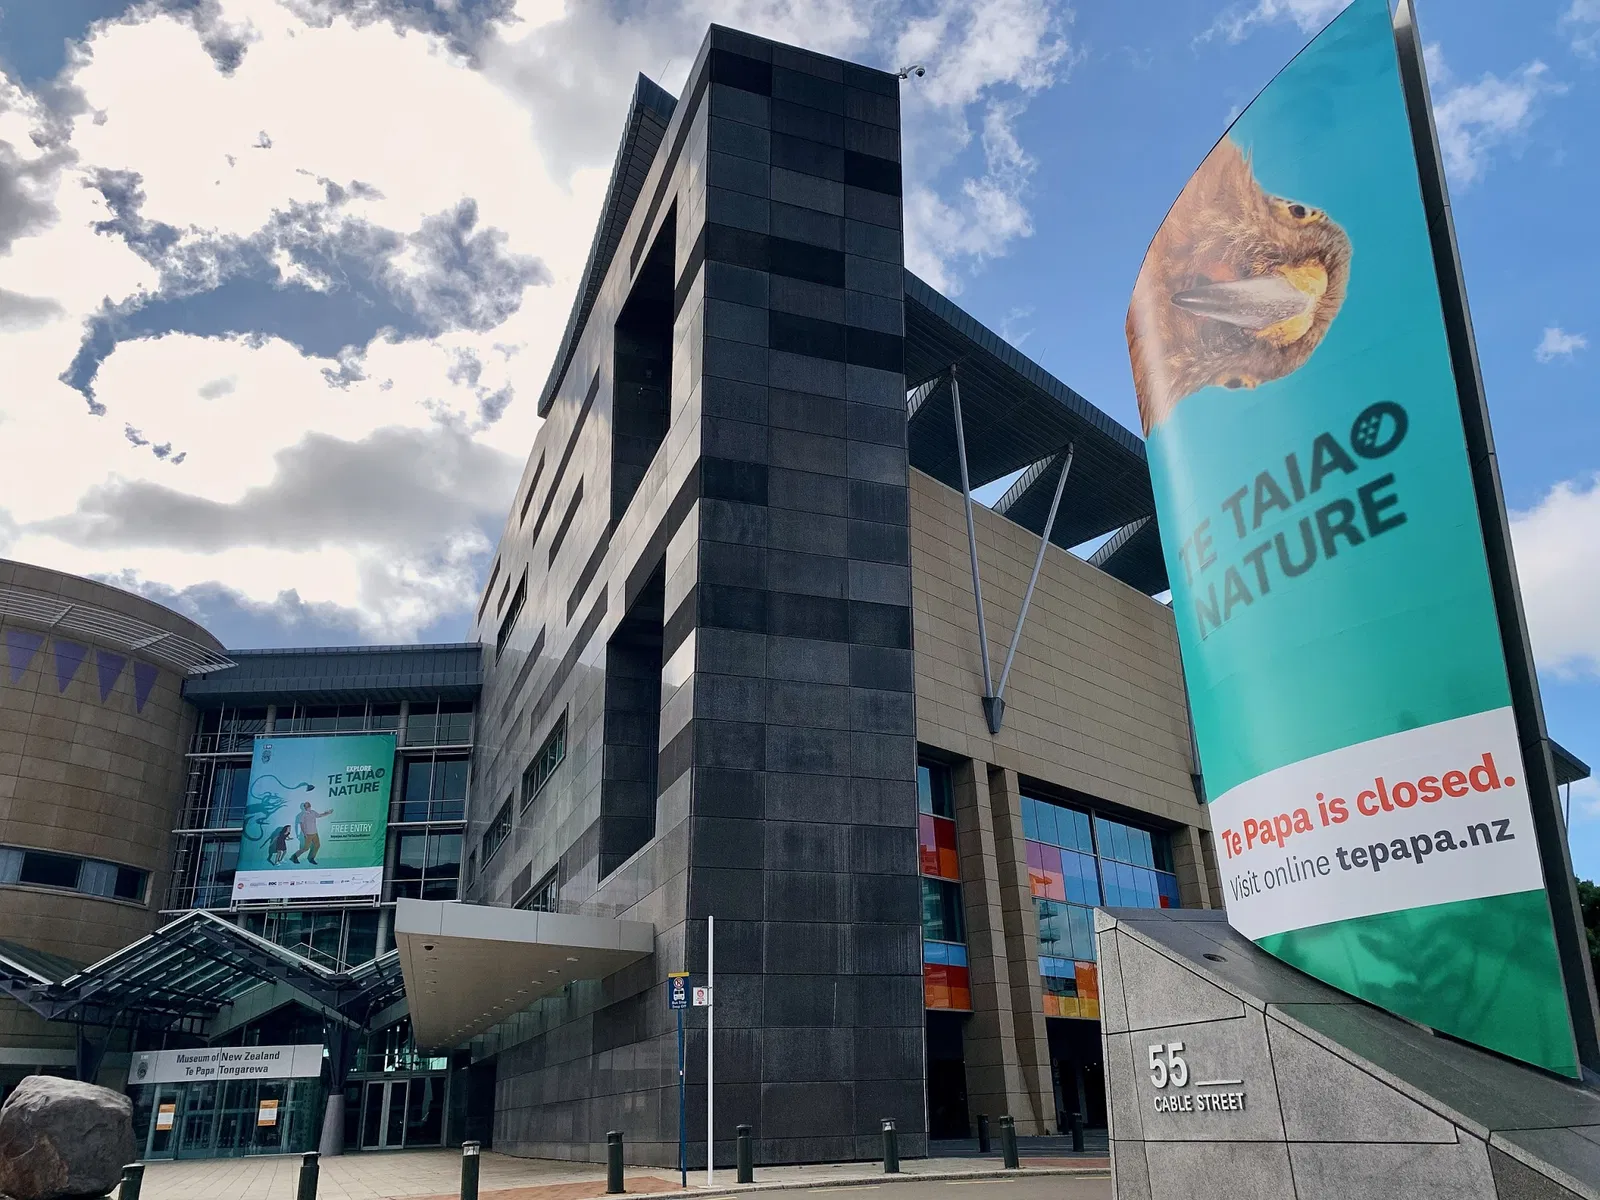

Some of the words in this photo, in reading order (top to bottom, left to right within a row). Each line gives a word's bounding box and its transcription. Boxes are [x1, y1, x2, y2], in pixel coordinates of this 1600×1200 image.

[1178, 518, 1217, 586] TE
[1194, 472, 1408, 641] NATURE
[327, 773, 342, 785] TE
[328, 781, 380, 798] NATURE
[1221, 828, 1242, 860] Te
[1243, 806, 1314, 850] Papa
[1315, 792, 1350, 828] is
[1356, 752, 1516, 817] closed.
[331, 824, 349, 833] FREE
[350, 823, 373, 833] ENTRY
[1230, 870, 1261, 901] Visit
[1264, 855, 1331, 890] online
[1335, 818, 1516, 873] tepapa.nz
[176, 1054, 210, 1063] Museum
[212, 1053, 220, 1062] of
[221, 1052, 242, 1062] New
[244, 1051, 281, 1061] Zealand
[1148, 1042, 1189, 1089] 55
[185, 1067, 194, 1076] Te
[195, 1066, 215, 1077] Papa
[219, 1065, 269, 1076] Tongarewa
[1154, 1095, 1193, 1112] CABLE
[1196, 1092, 1245, 1111] STREET
